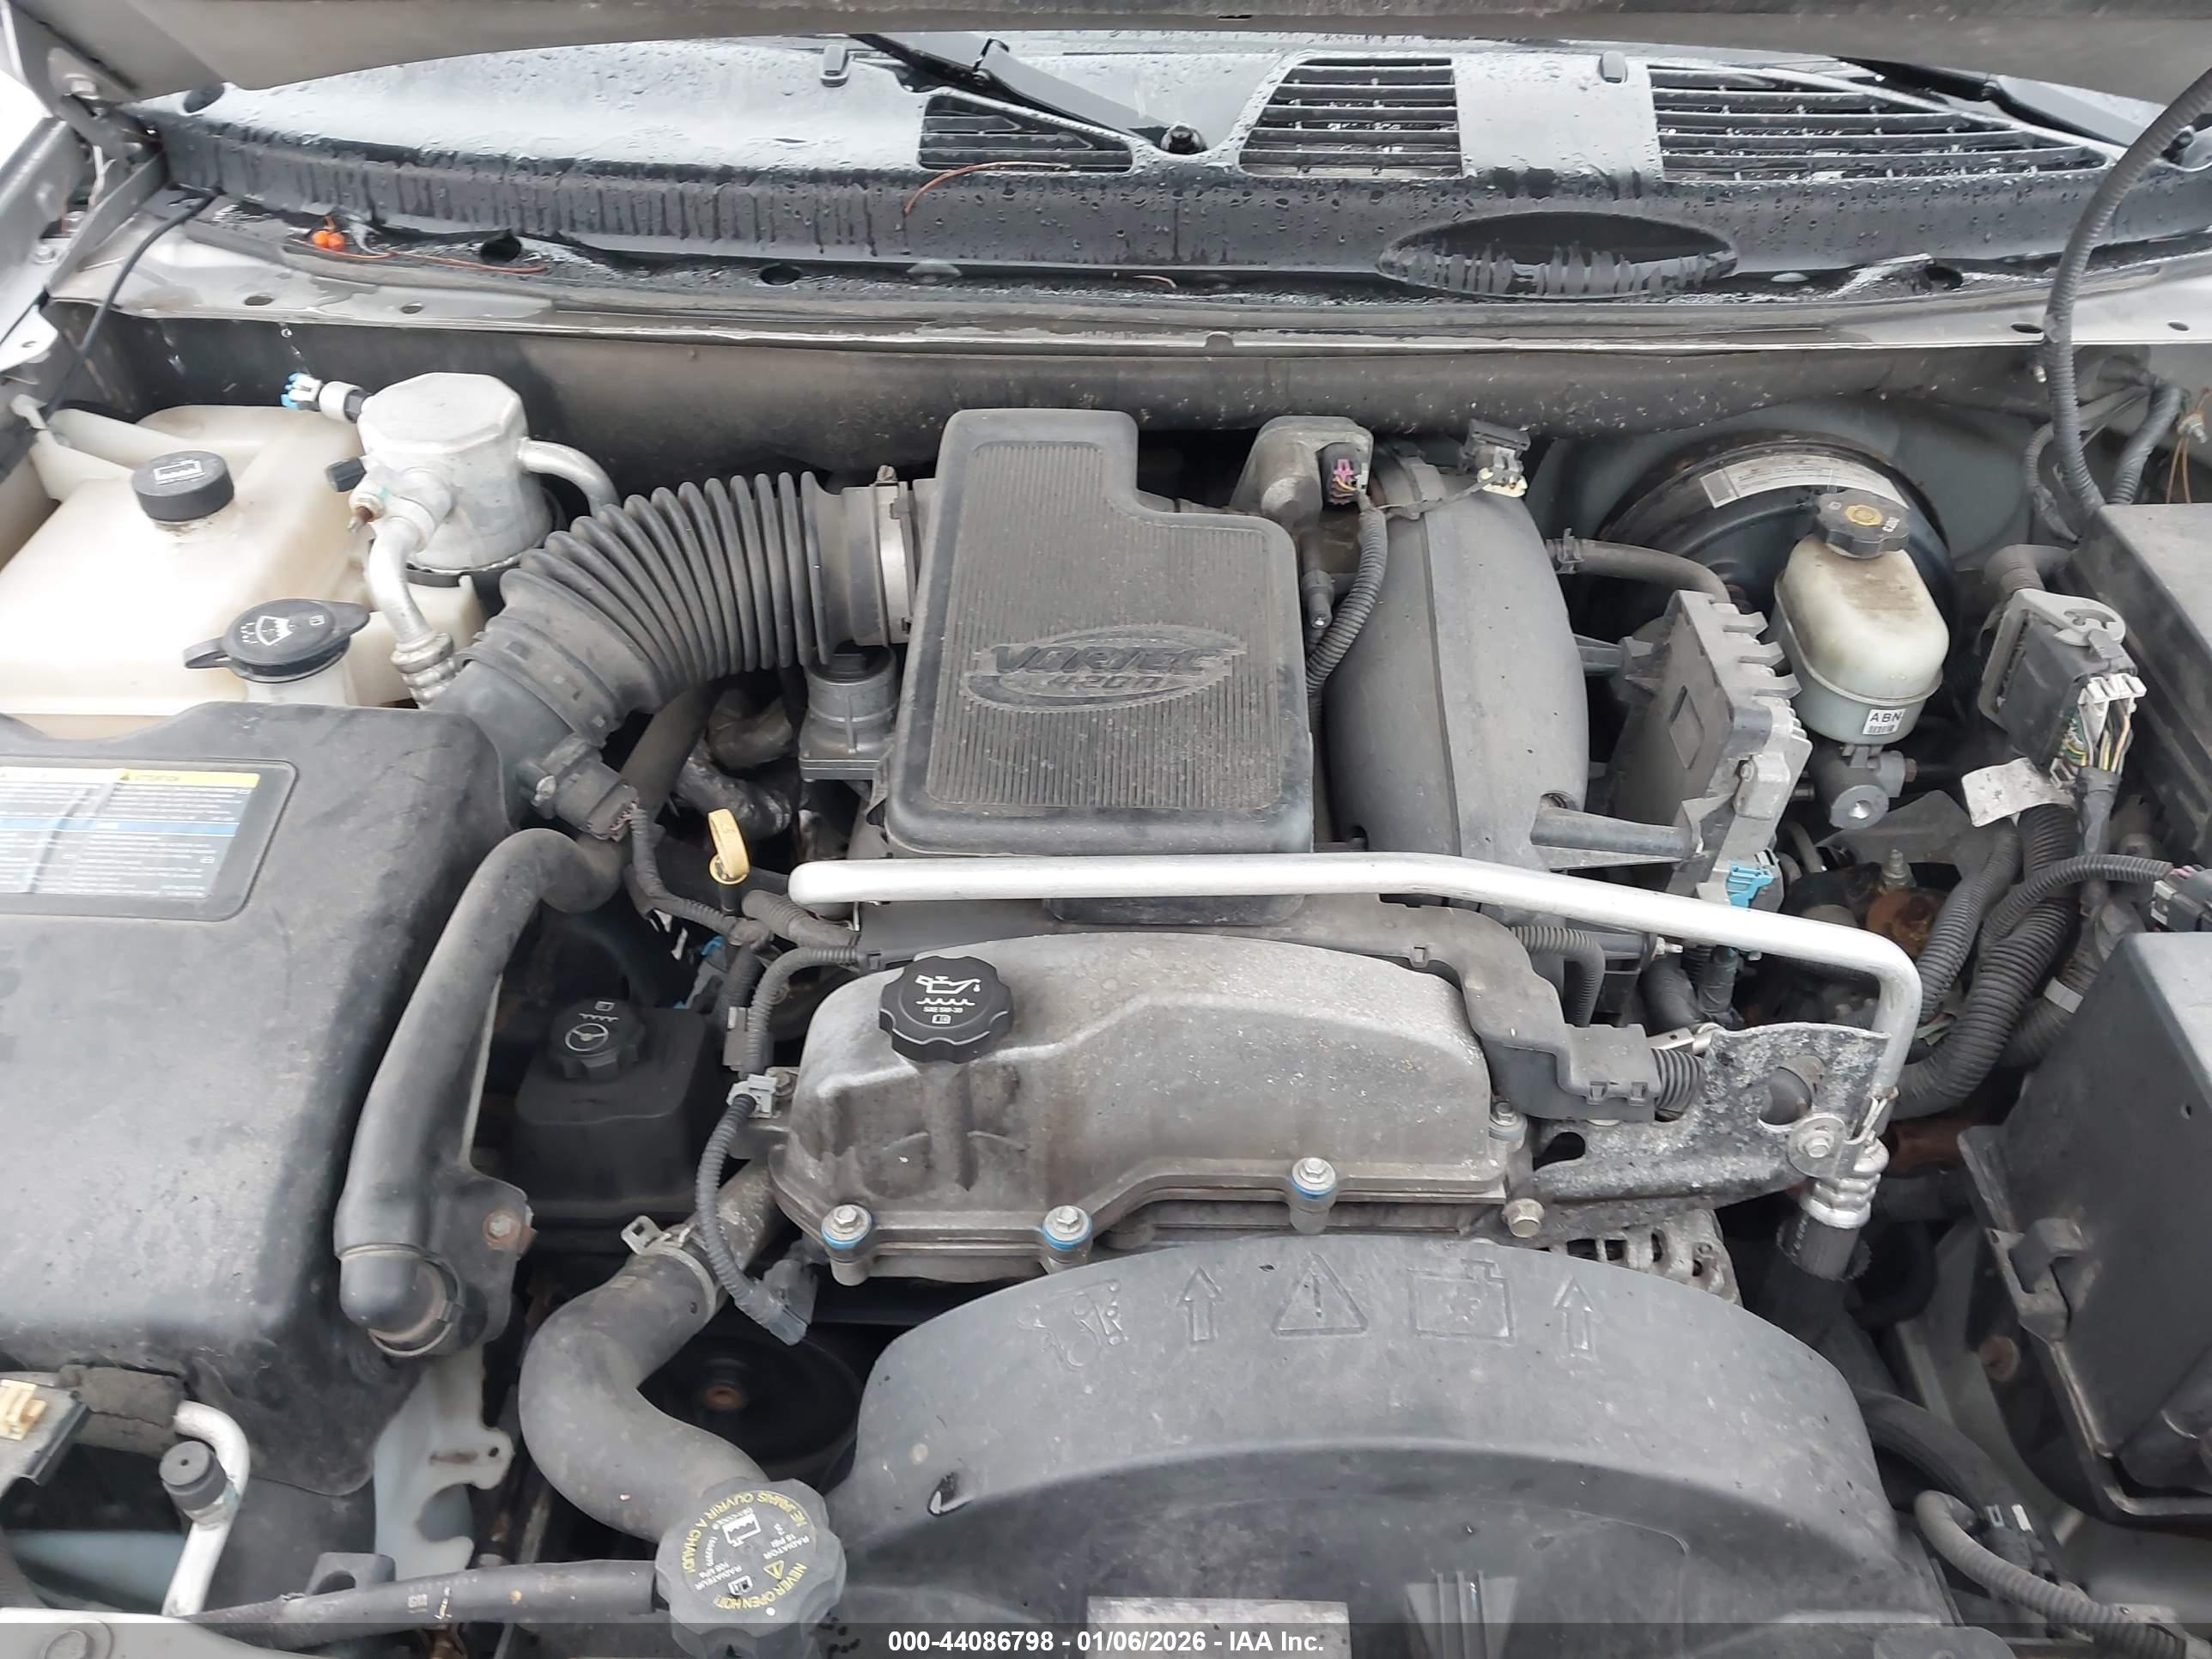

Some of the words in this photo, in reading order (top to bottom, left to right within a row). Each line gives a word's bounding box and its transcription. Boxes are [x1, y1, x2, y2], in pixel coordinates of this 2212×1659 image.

[991, 645, 1224, 674] VORTEC
[1869, 712, 1902, 723] ABN
[704, 1493, 754, 1520] OUVRIR
[773, 1562, 807, 1595] NEVER
[742, 1591, 775, 1608] OPEN
